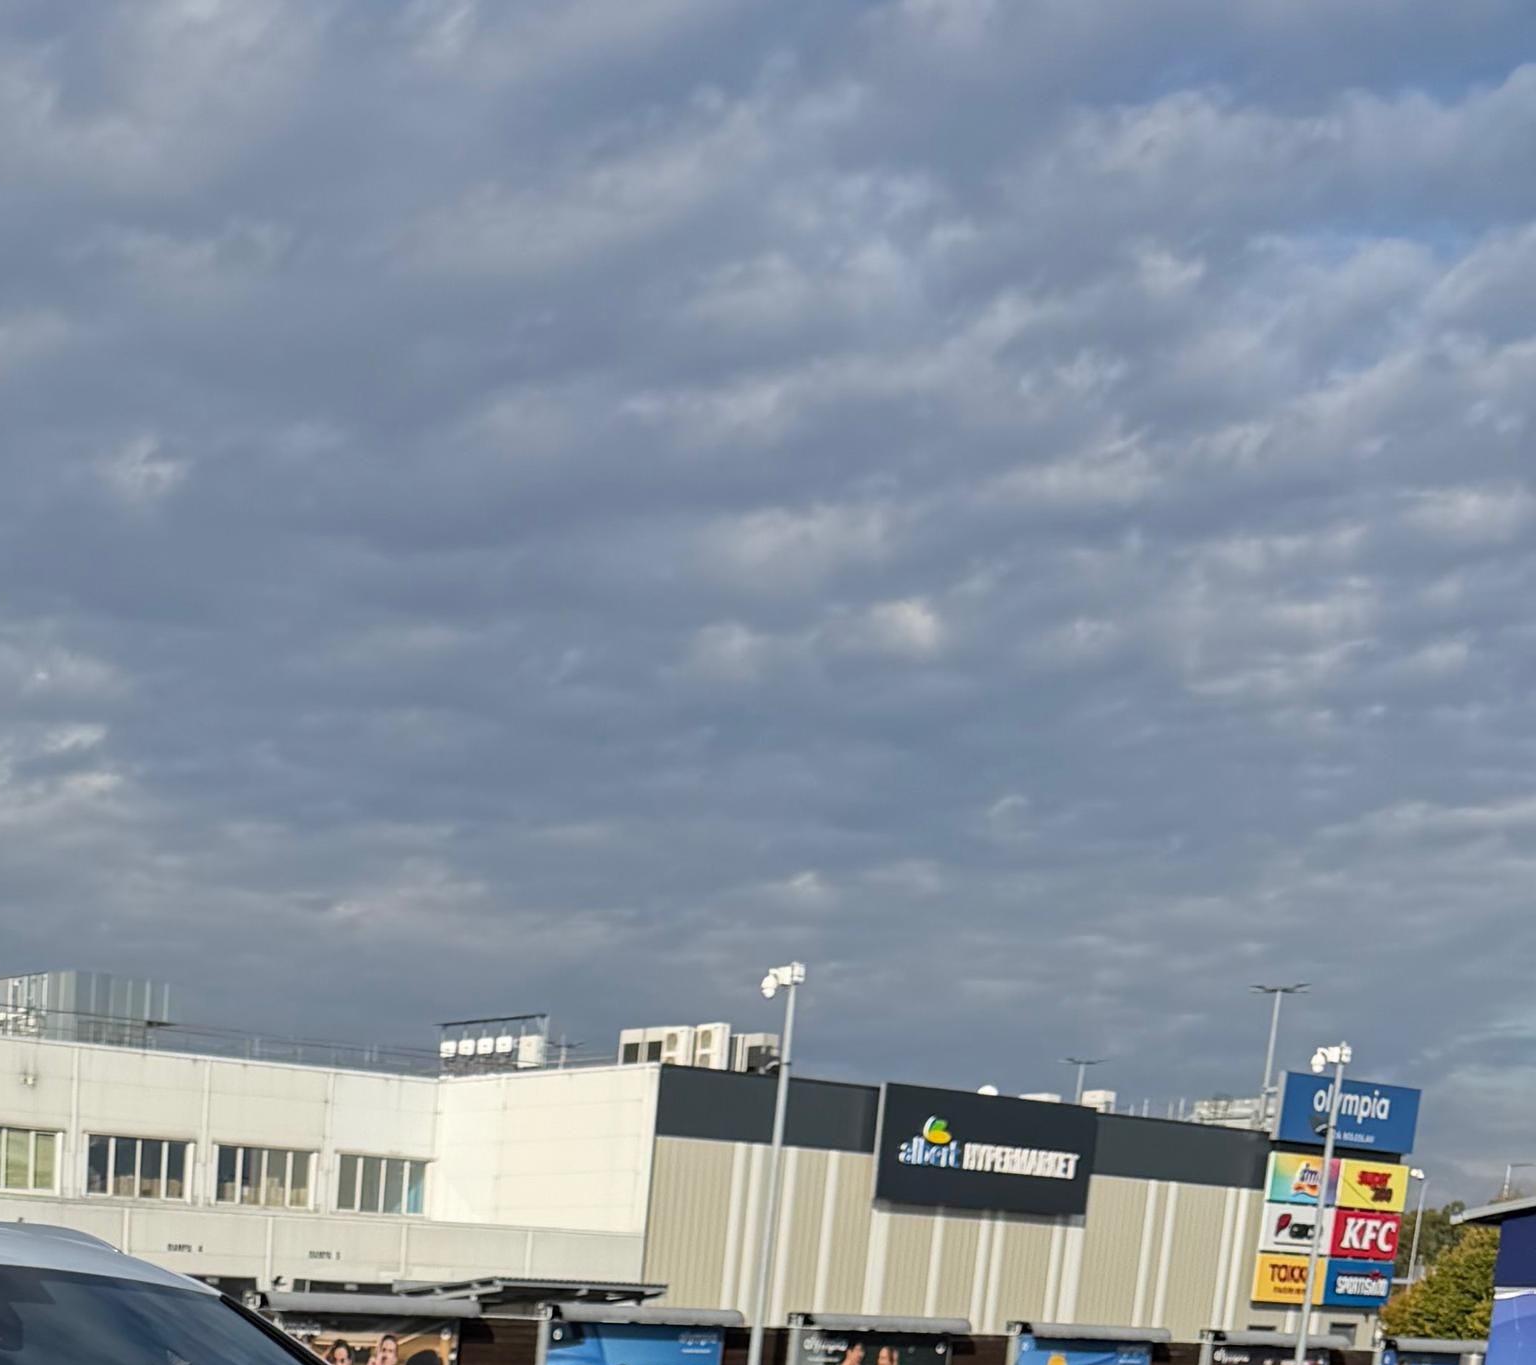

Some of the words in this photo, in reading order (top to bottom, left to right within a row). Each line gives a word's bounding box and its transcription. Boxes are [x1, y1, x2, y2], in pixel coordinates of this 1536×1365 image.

[898, 1135, 960, 1168] albert
[963, 1142, 1080, 1180] HYPERMARKET
[1340, 1217, 1397, 1252] KFC
